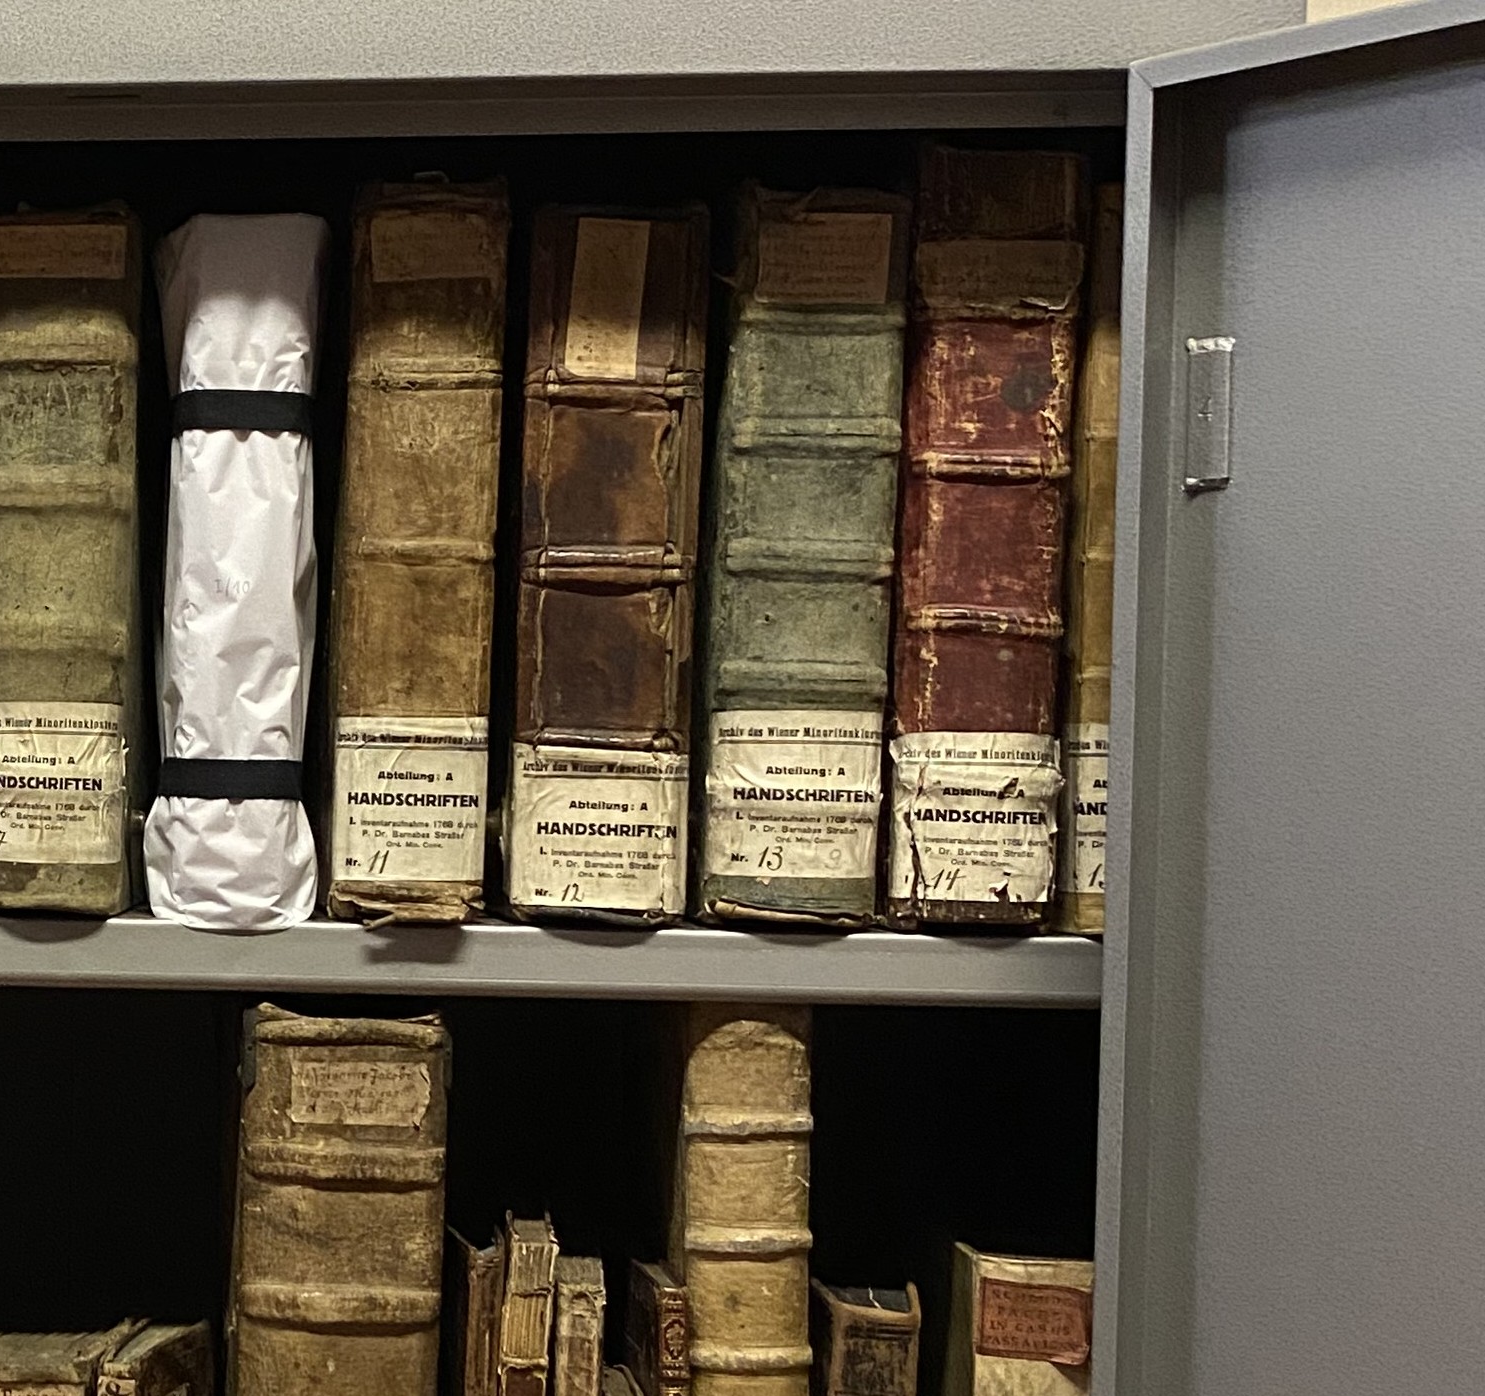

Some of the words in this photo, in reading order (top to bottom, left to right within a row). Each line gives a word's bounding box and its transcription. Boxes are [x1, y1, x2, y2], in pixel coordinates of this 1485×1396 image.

[215, 578, 250, 597] I/10
[5, 718, 32, 727] Wiener
[748, 728, 763, 737] des
[768, 727, 800, 737] Wiener
[945, 749, 977, 759] Wiener
[2, 755, 62, 765] Abteilung:
[67, 756, 75, 764] A
[572, 763, 603, 773] Wiener
[766, 766, 831, 777] Abteilung:
[378, 771, 440, 782] Abteilung:
[446, 773, 453, 781] A
[348, 792, 479, 807] HANDSCHRIFTEN
[733, 787, 875, 803] HANDSCHRIFTEN
[569, 801, 635, 812] Abteilung:
[640, 803, 647, 811] A
[346, 858, 361, 866] Nr.
[368, 850, 389, 874] 11
[731, 853, 748, 862] Nr.
[758, 846, 783, 871] 13
[931, 869, 966, 890] 14
[561, 884, 584, 901] 12
